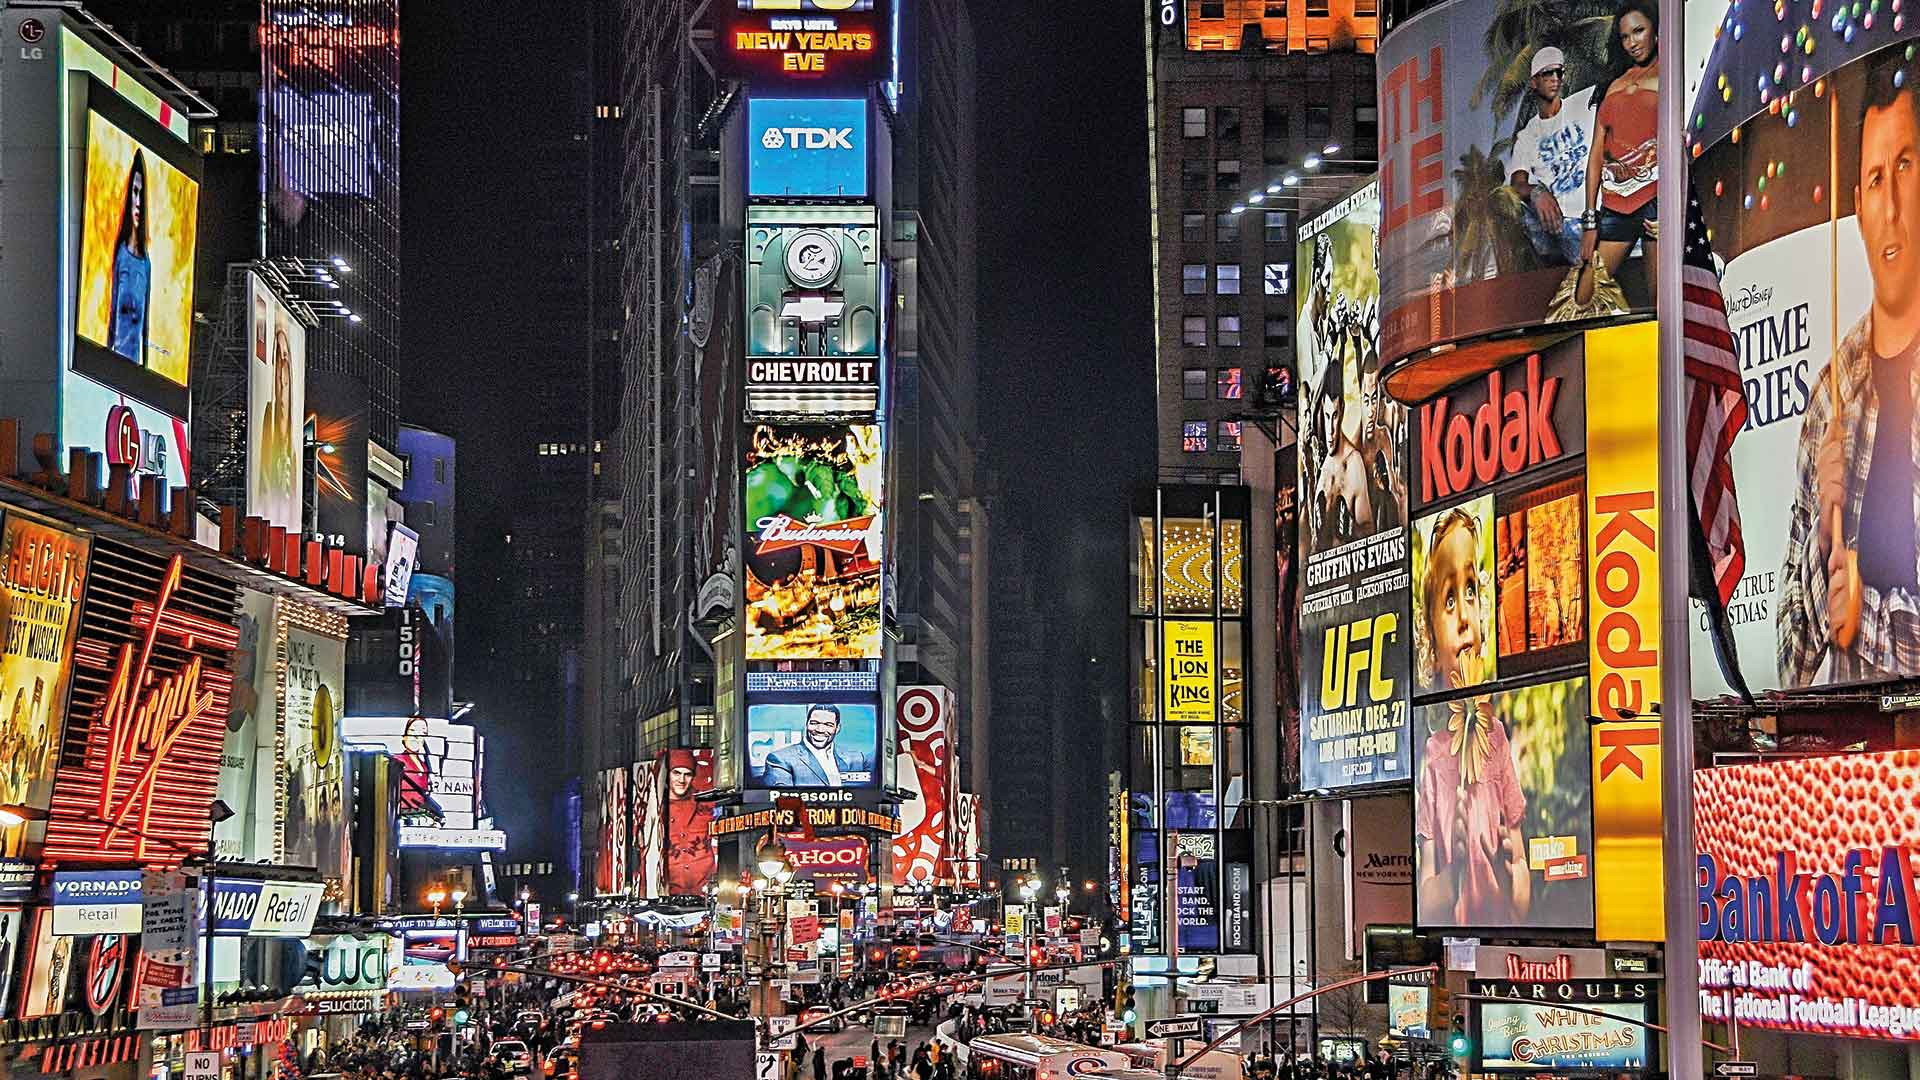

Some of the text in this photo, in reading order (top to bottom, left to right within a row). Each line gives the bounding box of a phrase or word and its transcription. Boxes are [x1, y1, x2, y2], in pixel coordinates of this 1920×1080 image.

[736, 32, 872, 50] NEW YEAR'S
[20, 48, 43, 60] LG
[783, 53, 825, 71] EVE
[782, 127, 853, 149] TDK
[1297, 220, 1314, 243] THE
[751, 362, 873, 382] CHEVROLET
[1743, 358, 1810, 433] RIES
[1420, 353, 1562, 504] Kodak
[140, 428, 167, 477] LG
[328, 534, 346, 547] 14
[755, 516, 875, 543] Budweiser
[1306, 552, 1352, 588] GRIFFIN
[1351, 548, 1367, 575] VS
[1367, 536, 1406, 569] EVANS
[1356, 581, 1386, 605] JACKSON
[1743, 571, 1776, 599] TRUE
[1699, 598, 1769, 632] CSTMAS
[4, 615, 63, 663] BEST MUSICAL
[400, 608, 413, 677] 1500
[1175, 639, 1204, 655] THE
[1595, 490, 1661, 784] Kodak
[1320, 612, 1398, 712] UFC
[766, 676, 798, 688] News
[1310, 700, 1406, 741] SATURDAY, DEC. 27
[799, 808, 836, 826] ROM
[1548, 861, 1584, 878] something
[55, 879, 143, 894] VORNADO
[1177, 886, 1206, 895] START
[1696, 849, 1804, 945] Bank
[1812, 847, 1866, 946] of
[264, 892, 312, 923] Retail
[1181, 896, 1210, 905] BAND.
[1197, 907, 1214, 916] THE
[1232, 866, 1241, 947] ROCKBAND.COM
[77, 907, 119, 921] Retail
[1036, 971, 1060, 983] udget
[1506, 952, 1570, 982] Marriott
[1749, 961, 1791, 989] Bank
[1791, 964, 1812, 991] of
[1480, 983, 1646, 999] MARQUIS
[318, 999, 372, 1013] swatch
[1535, 1006, 1603, 1029] WHITE
[1698, 990, 1723, 1017] The
[1789, 994, 1855, 1026] Football
[1858, 996, 1920, 1034] League
[1153, 1022, 1195, 1034] ONE WAY
[1512, 1027, 1636, 1064] CHRISTMAS
[194, 1058, 210, 1070] NO
